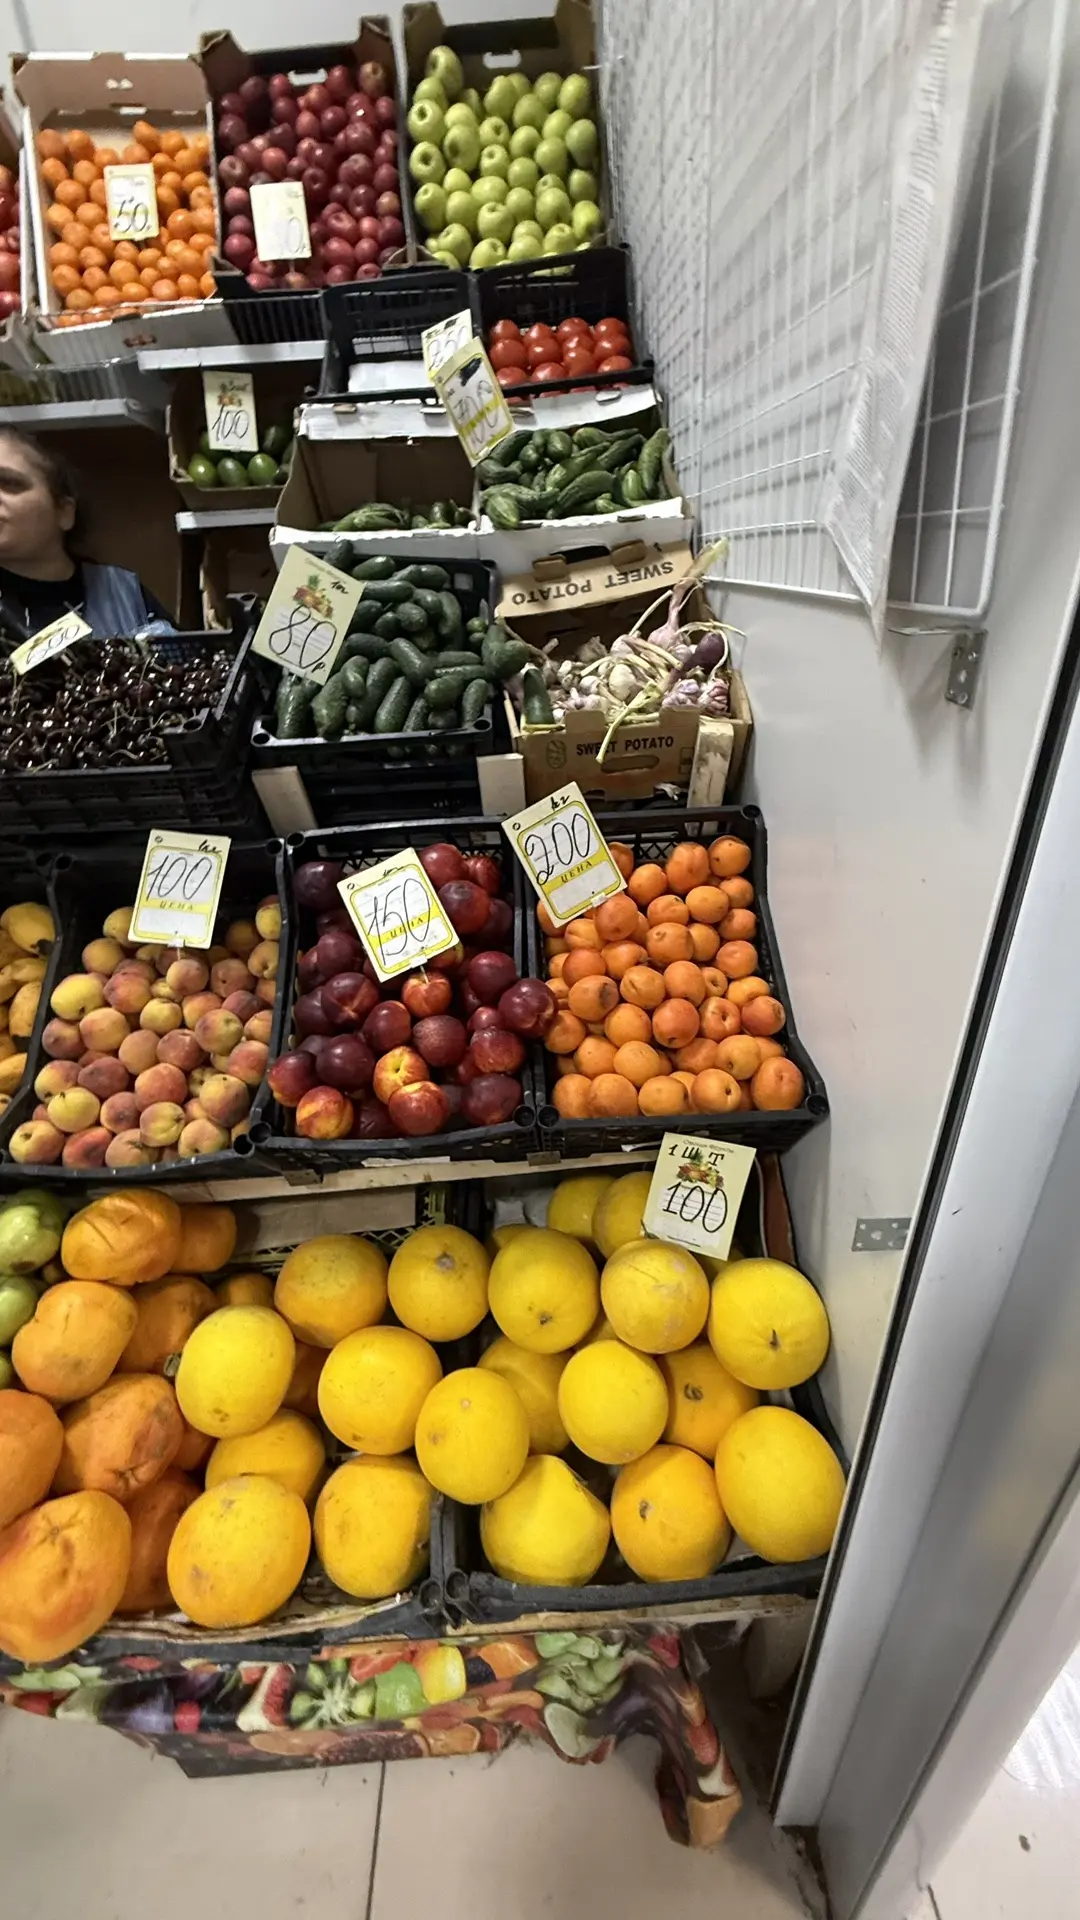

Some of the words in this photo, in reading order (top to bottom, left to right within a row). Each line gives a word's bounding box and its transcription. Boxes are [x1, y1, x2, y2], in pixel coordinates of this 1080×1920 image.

[212, 404, 250, 442] 100
[605, 561, 674, 589] SWEET
[512, 579, 593, 606] POTATO
[269, 604, 337, 670] 80
[625, 736, 673, 751] POTATO
[525, 812, 590, 886] 200
[146, 855, 213, 902] 100
[560, 860, 593, 883] ЦЕНА
[160, 900, 194, 911] ЦЕНА
[368, 878, 431, 966] 150
[668, 1144, 678, 1156] 1
[663, 1182, 728, 1233] 100
